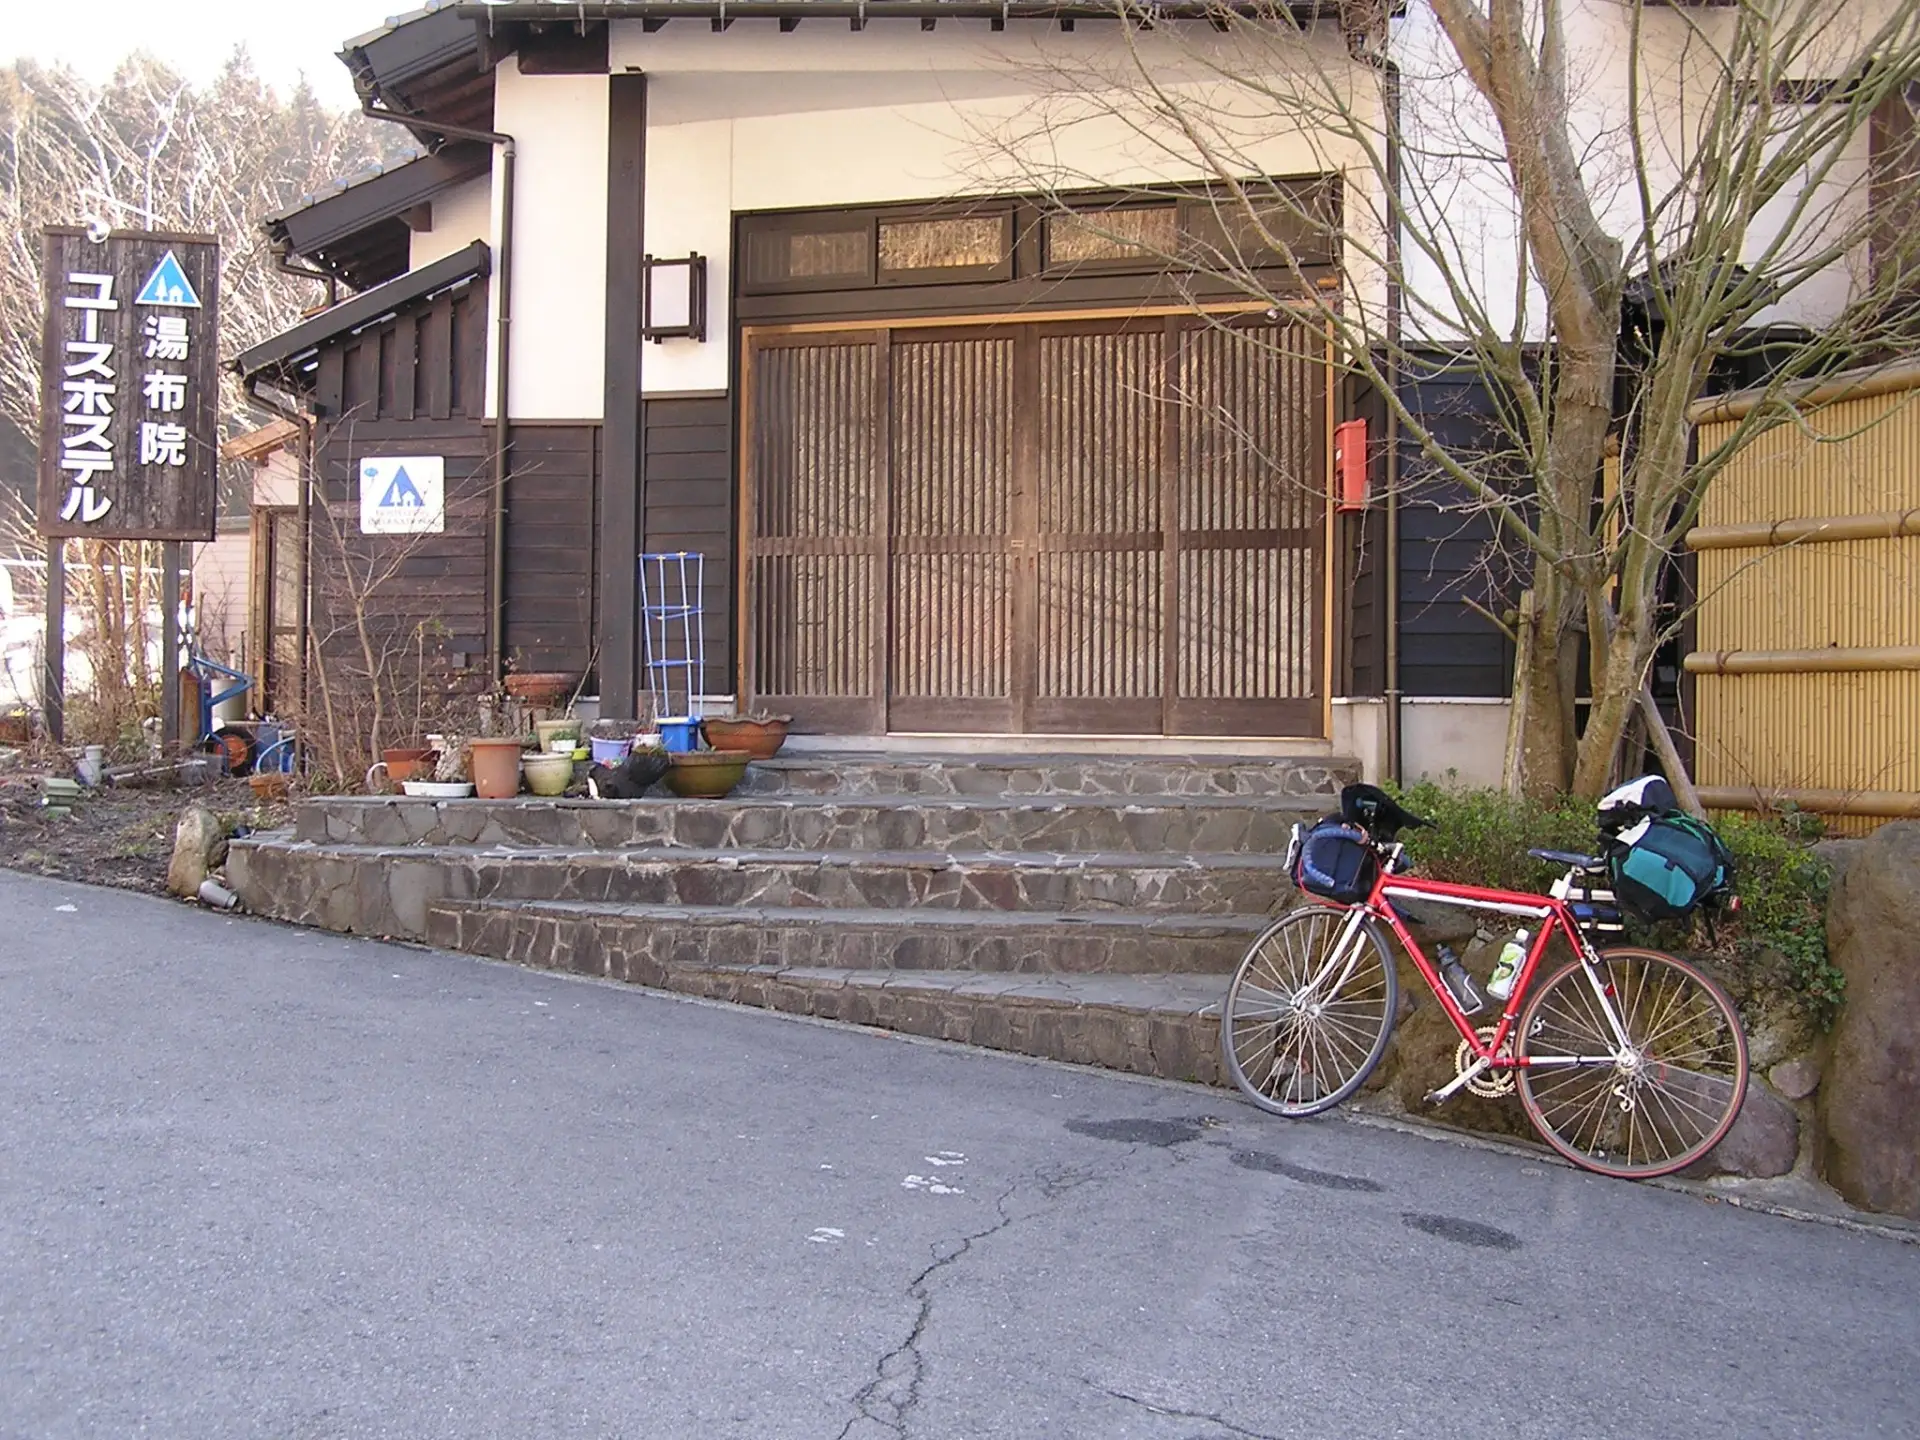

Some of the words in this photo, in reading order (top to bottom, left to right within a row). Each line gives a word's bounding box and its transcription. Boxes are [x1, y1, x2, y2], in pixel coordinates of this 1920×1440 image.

[61, 273, 118, 523] ユースホステル
[141, 316, 189, 466] 湯布院
